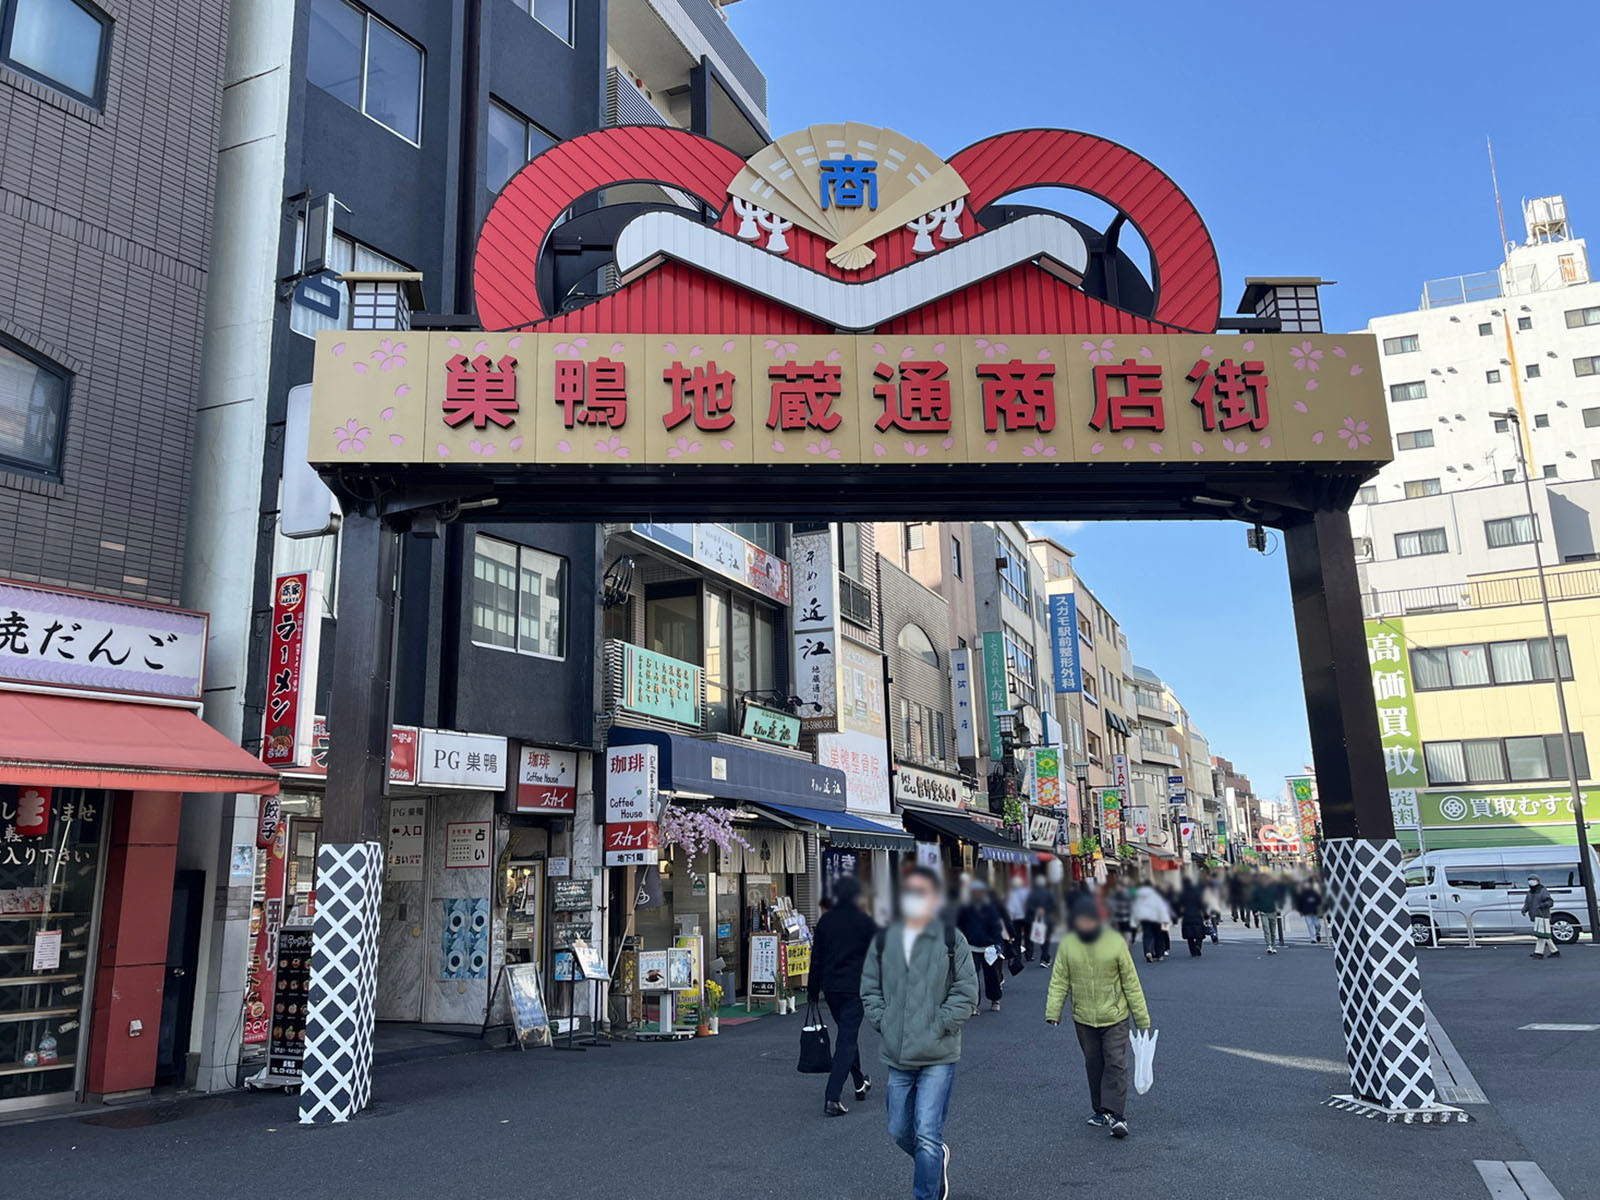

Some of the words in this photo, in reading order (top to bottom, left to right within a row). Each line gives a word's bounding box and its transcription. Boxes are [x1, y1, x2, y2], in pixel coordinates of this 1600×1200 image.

[819, 154, 878, 211] 商
[442, 354, 1269, 432] 巣鴨地蔵通商店街
[0, 611, 178, 670] 焼だんご
[1055, 596, 1077, 690] スガモ駅前整形外科
[271, 613, 297, 723] ラーメン
[1367, 633, 1419, 776] 高価買取
[433, 749, 460, 770] PG
[466, 752, 498, 774] 巣鴨
[528, 752, 550, 769] 珈琲
[610, 753, 645, 774] 珈琲
[526, 772, 543, 783] Coffee
[544, 774, 559, 785] House
[541, 788, 568, 807] スカイ
[610, 798, 635, 809] Coffee
[1470, 793, 1588, 819] 買取むすび
[262, 800, 280, 839] 餃子
[621, 810, 643, 819] House
[402, 825, 422, 837] 入口
[609, 825, 647, 847] スカイ
[474, 828, 486, 861] 占い
[617, 853, 644, 863] 地下1階
[759, 941, 771, 949] 1F
